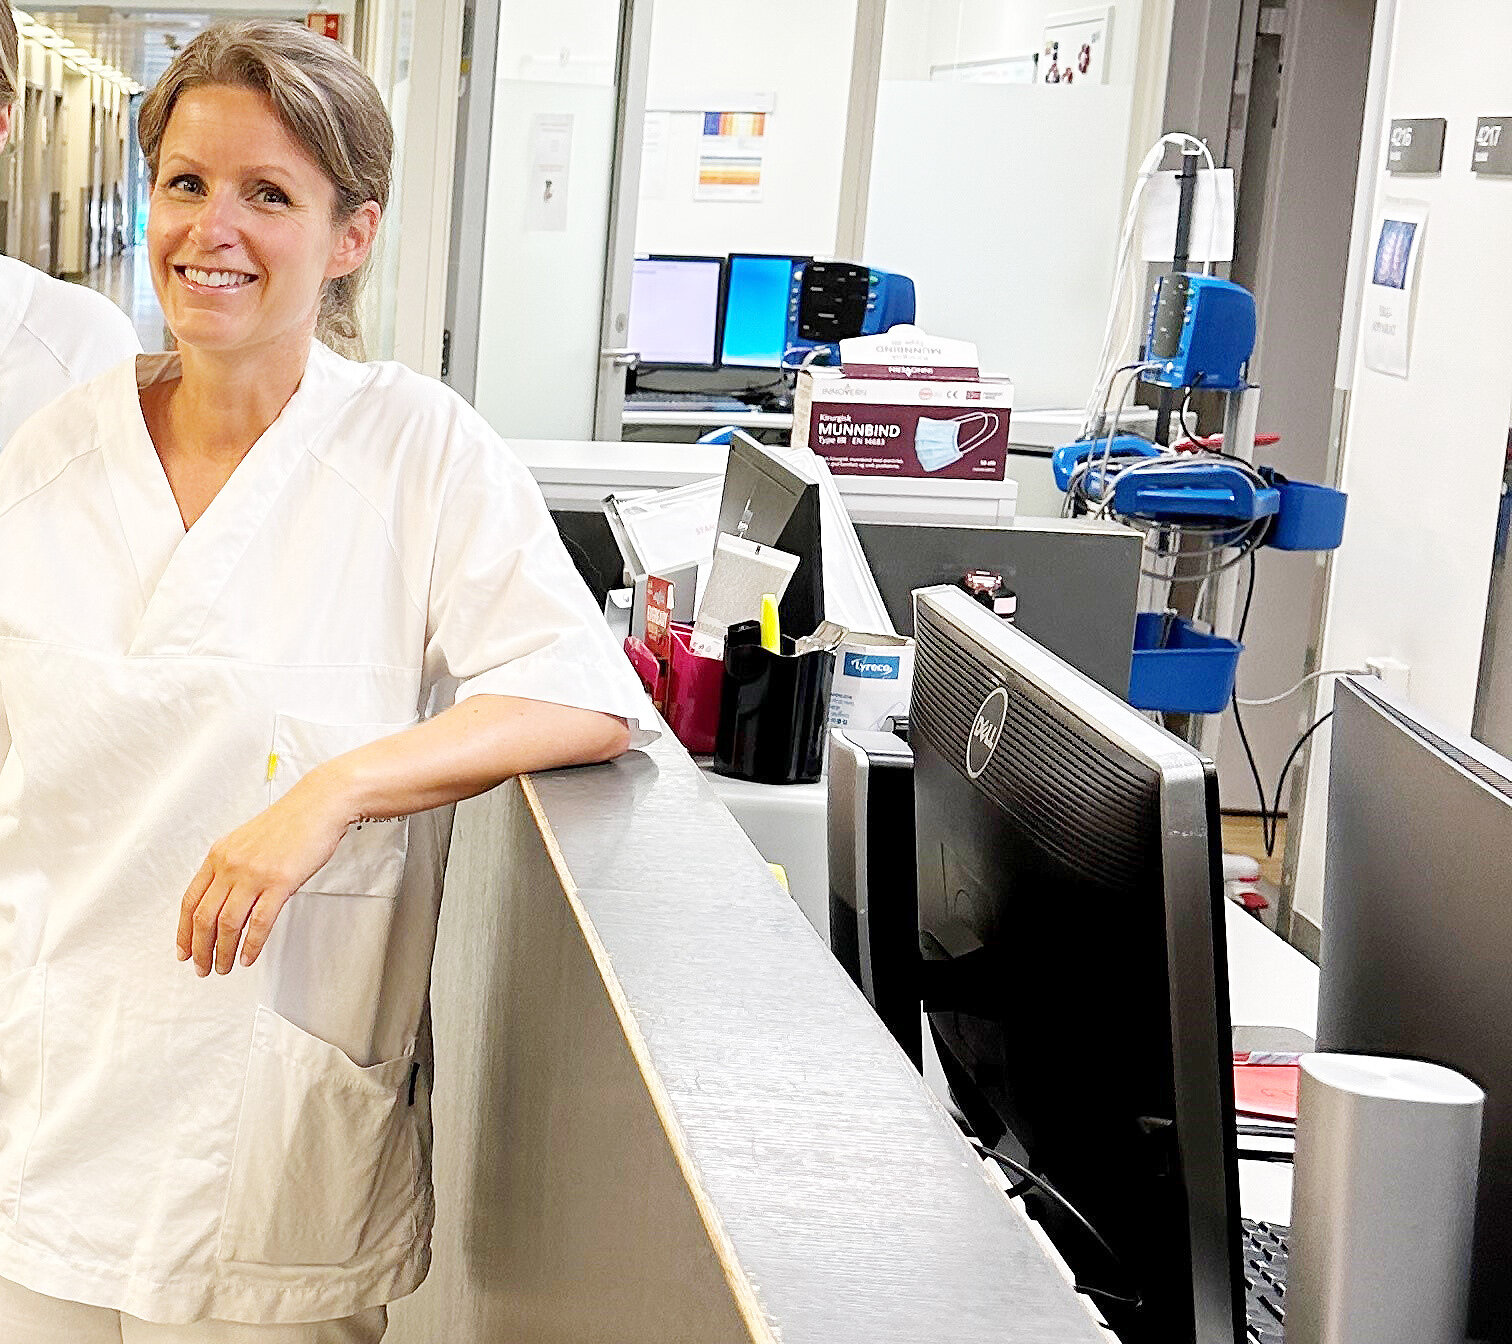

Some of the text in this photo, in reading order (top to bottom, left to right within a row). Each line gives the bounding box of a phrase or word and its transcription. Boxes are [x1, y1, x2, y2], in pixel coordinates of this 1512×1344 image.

[818, 422, 901, 438] MUNNBIND
[851, 658, 893, 675] Lyreco
[974, 715, 998, 750] DELL
